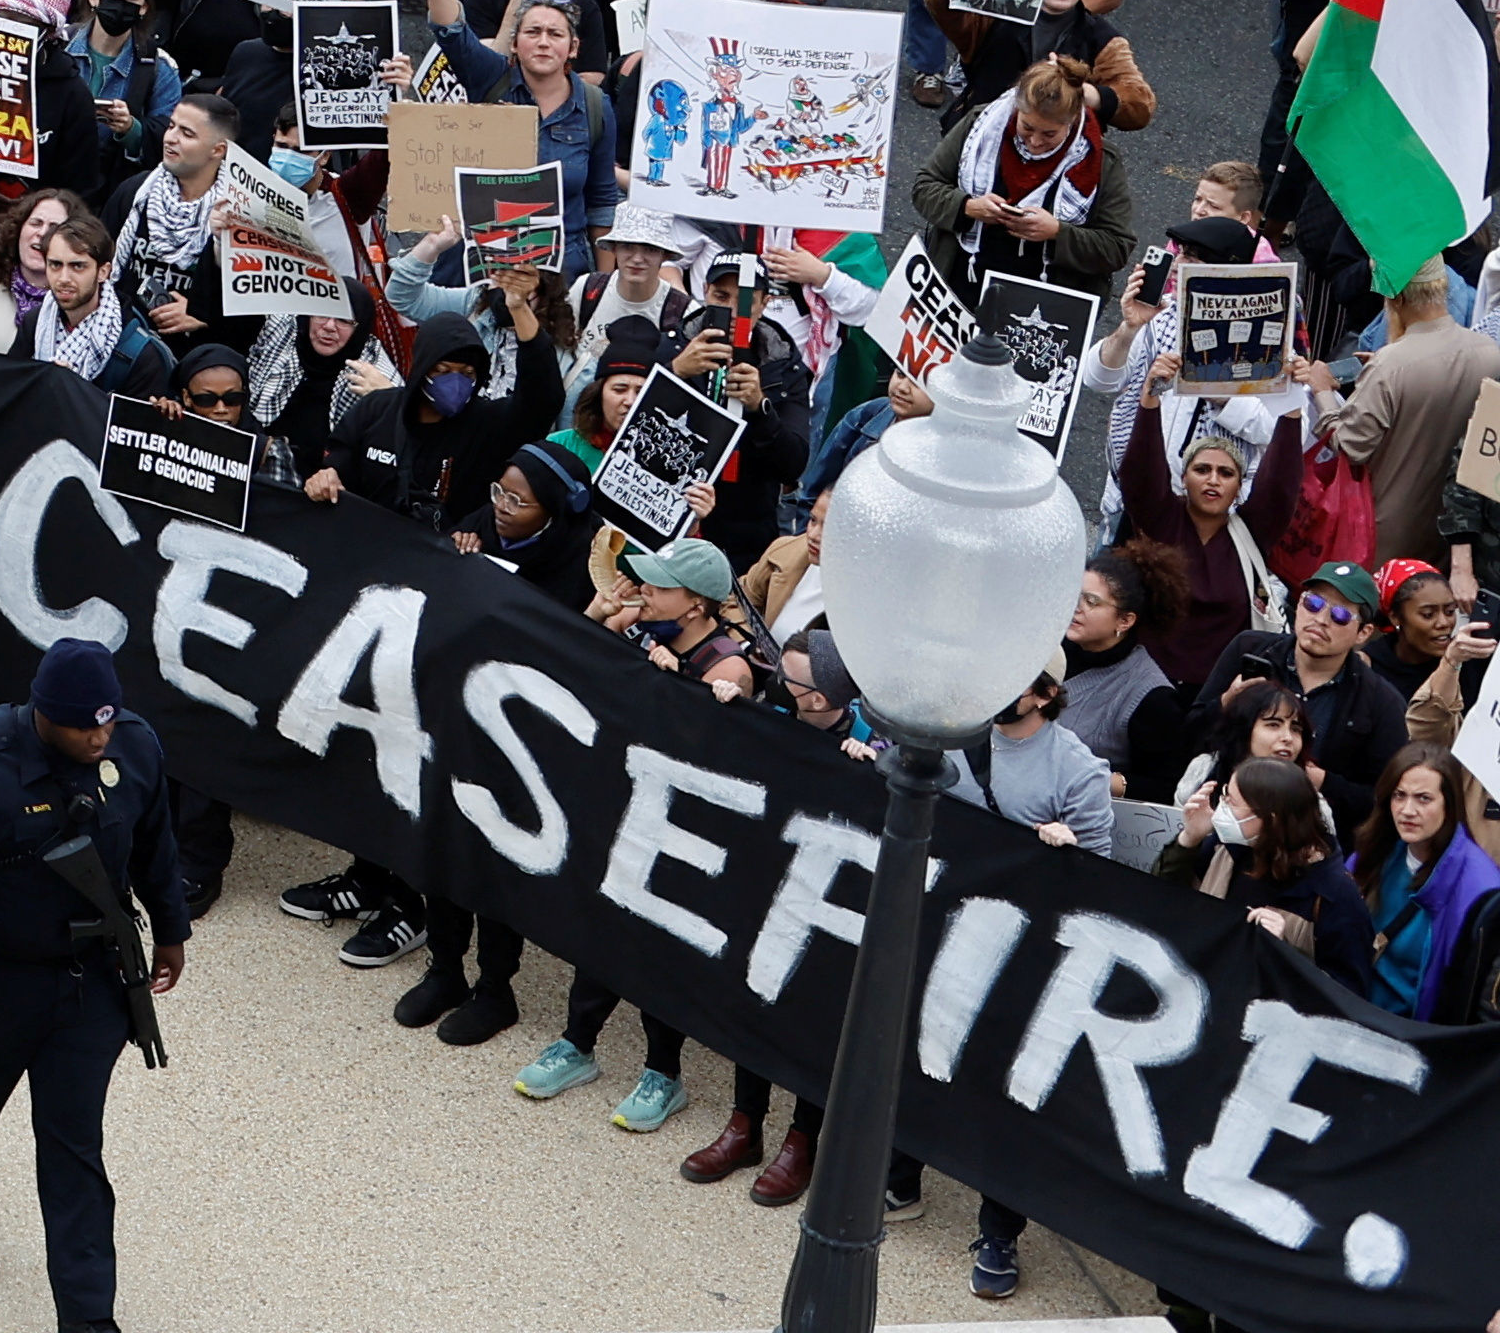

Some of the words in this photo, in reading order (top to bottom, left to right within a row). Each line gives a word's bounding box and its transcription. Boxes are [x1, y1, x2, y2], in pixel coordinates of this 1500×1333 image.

[109, 425, 167, 454] SETTLER
[168, 439, 248, 482] COLONIALISM
[138, 453, 153, 471] IS
[154, 457, 216, 493] GENOCIDE
[366, 446, 397, 467] NASA
